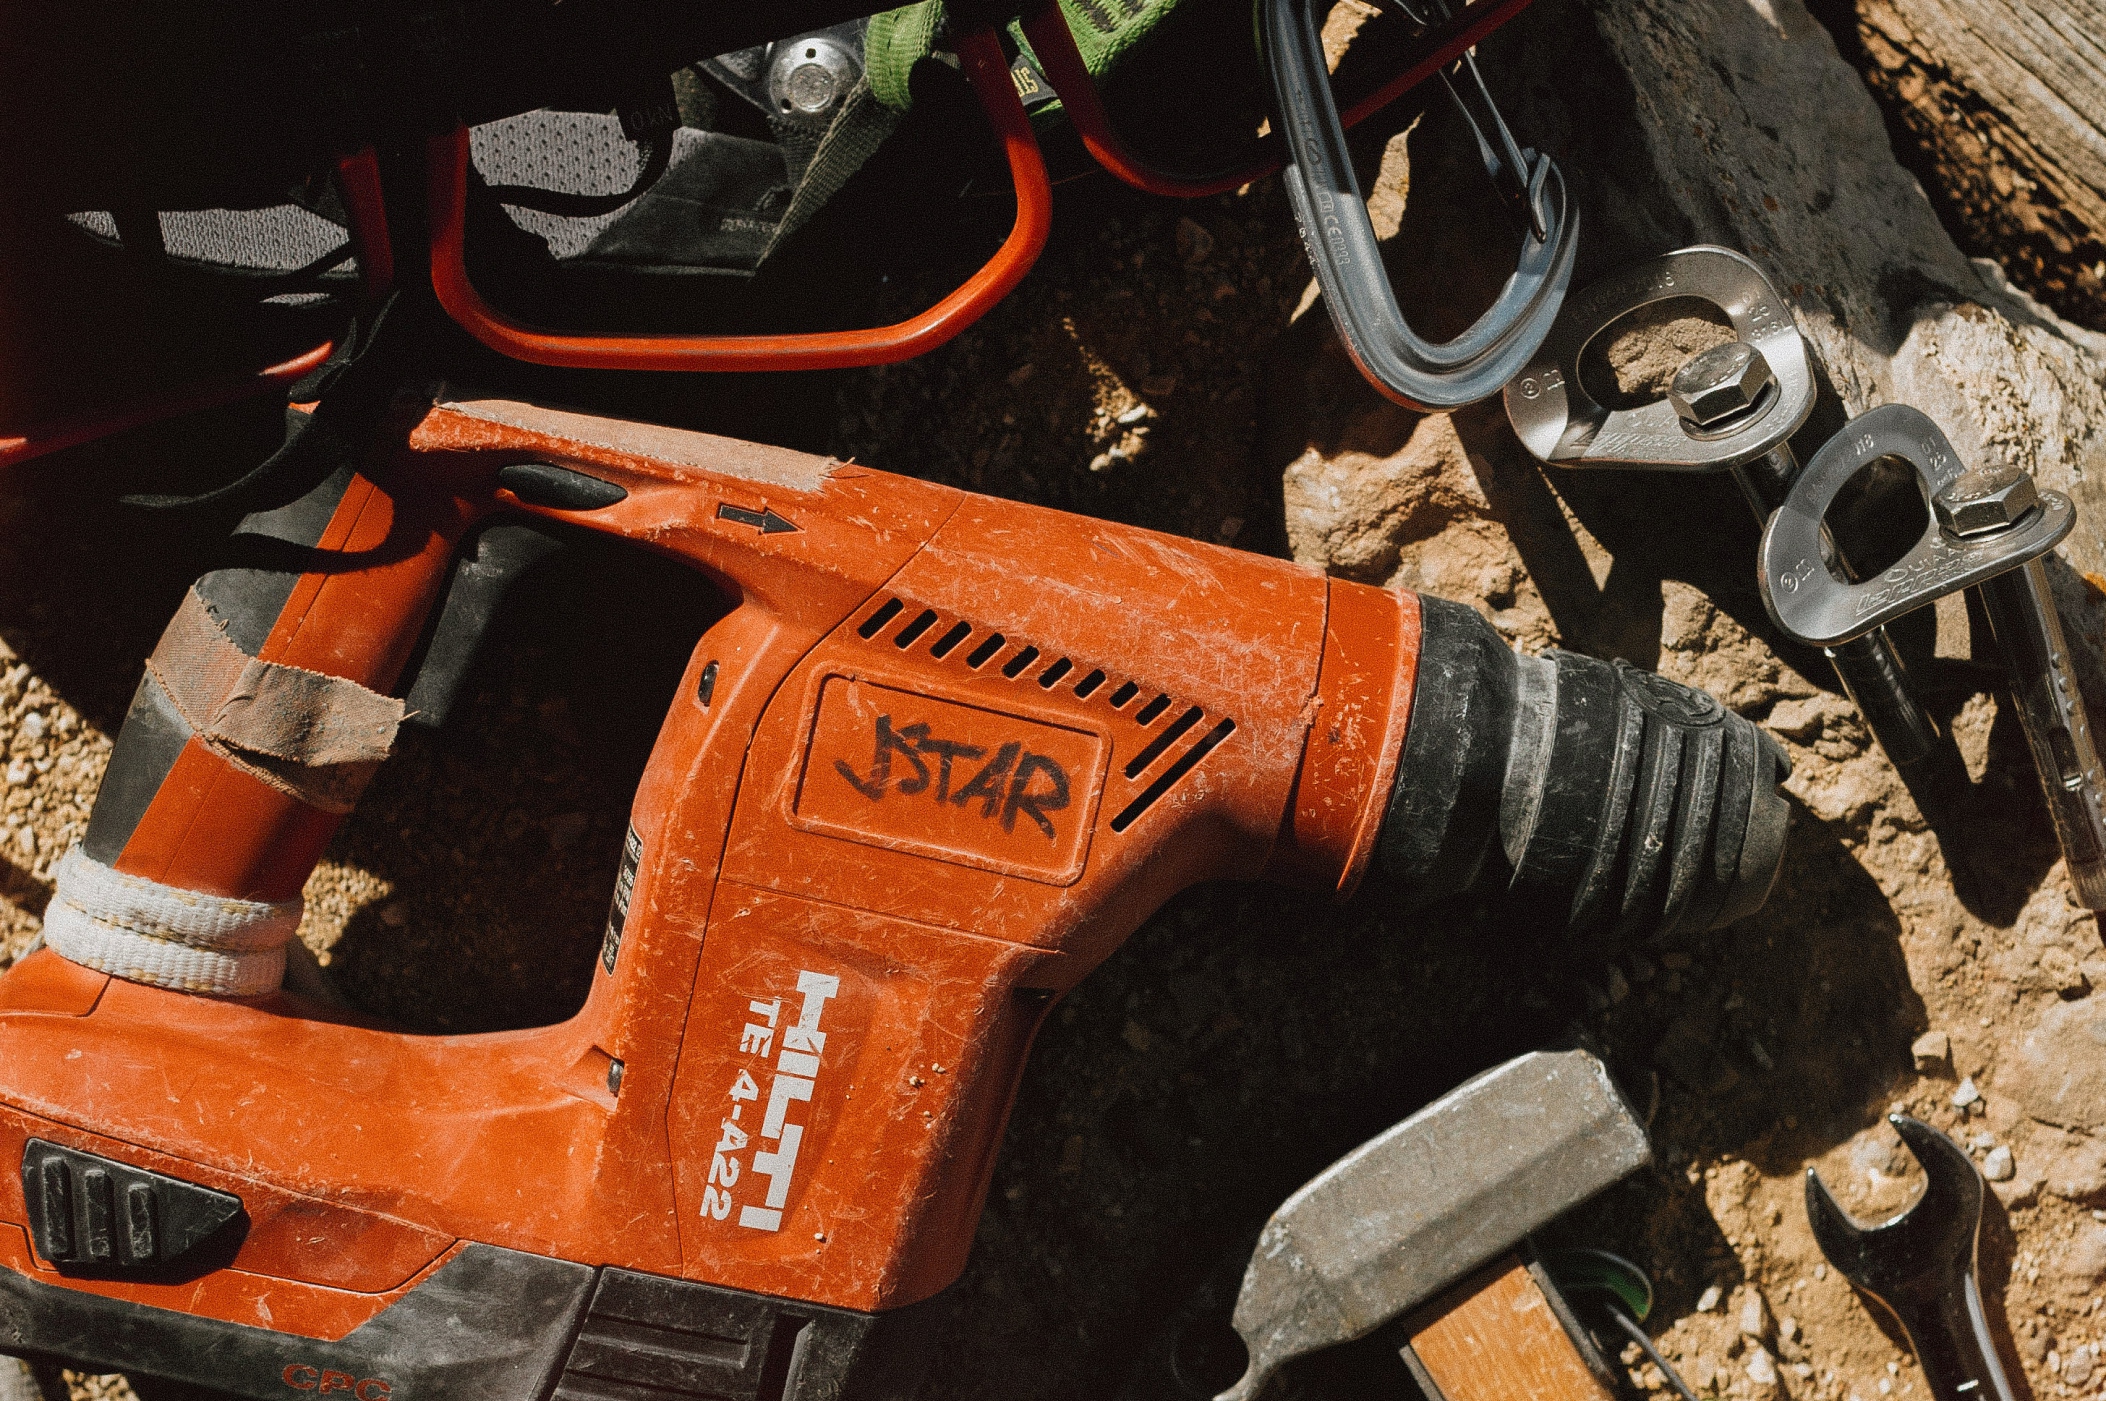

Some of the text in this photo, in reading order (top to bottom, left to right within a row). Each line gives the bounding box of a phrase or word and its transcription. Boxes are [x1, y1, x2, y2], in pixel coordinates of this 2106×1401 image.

[833, 714, 1072, 840] JSTAR
[699, 996, 782, 1222] TE 4-A22
[739, 970, 840, 1232] HILTI
[281, 1363, 393, 1401] CPC
